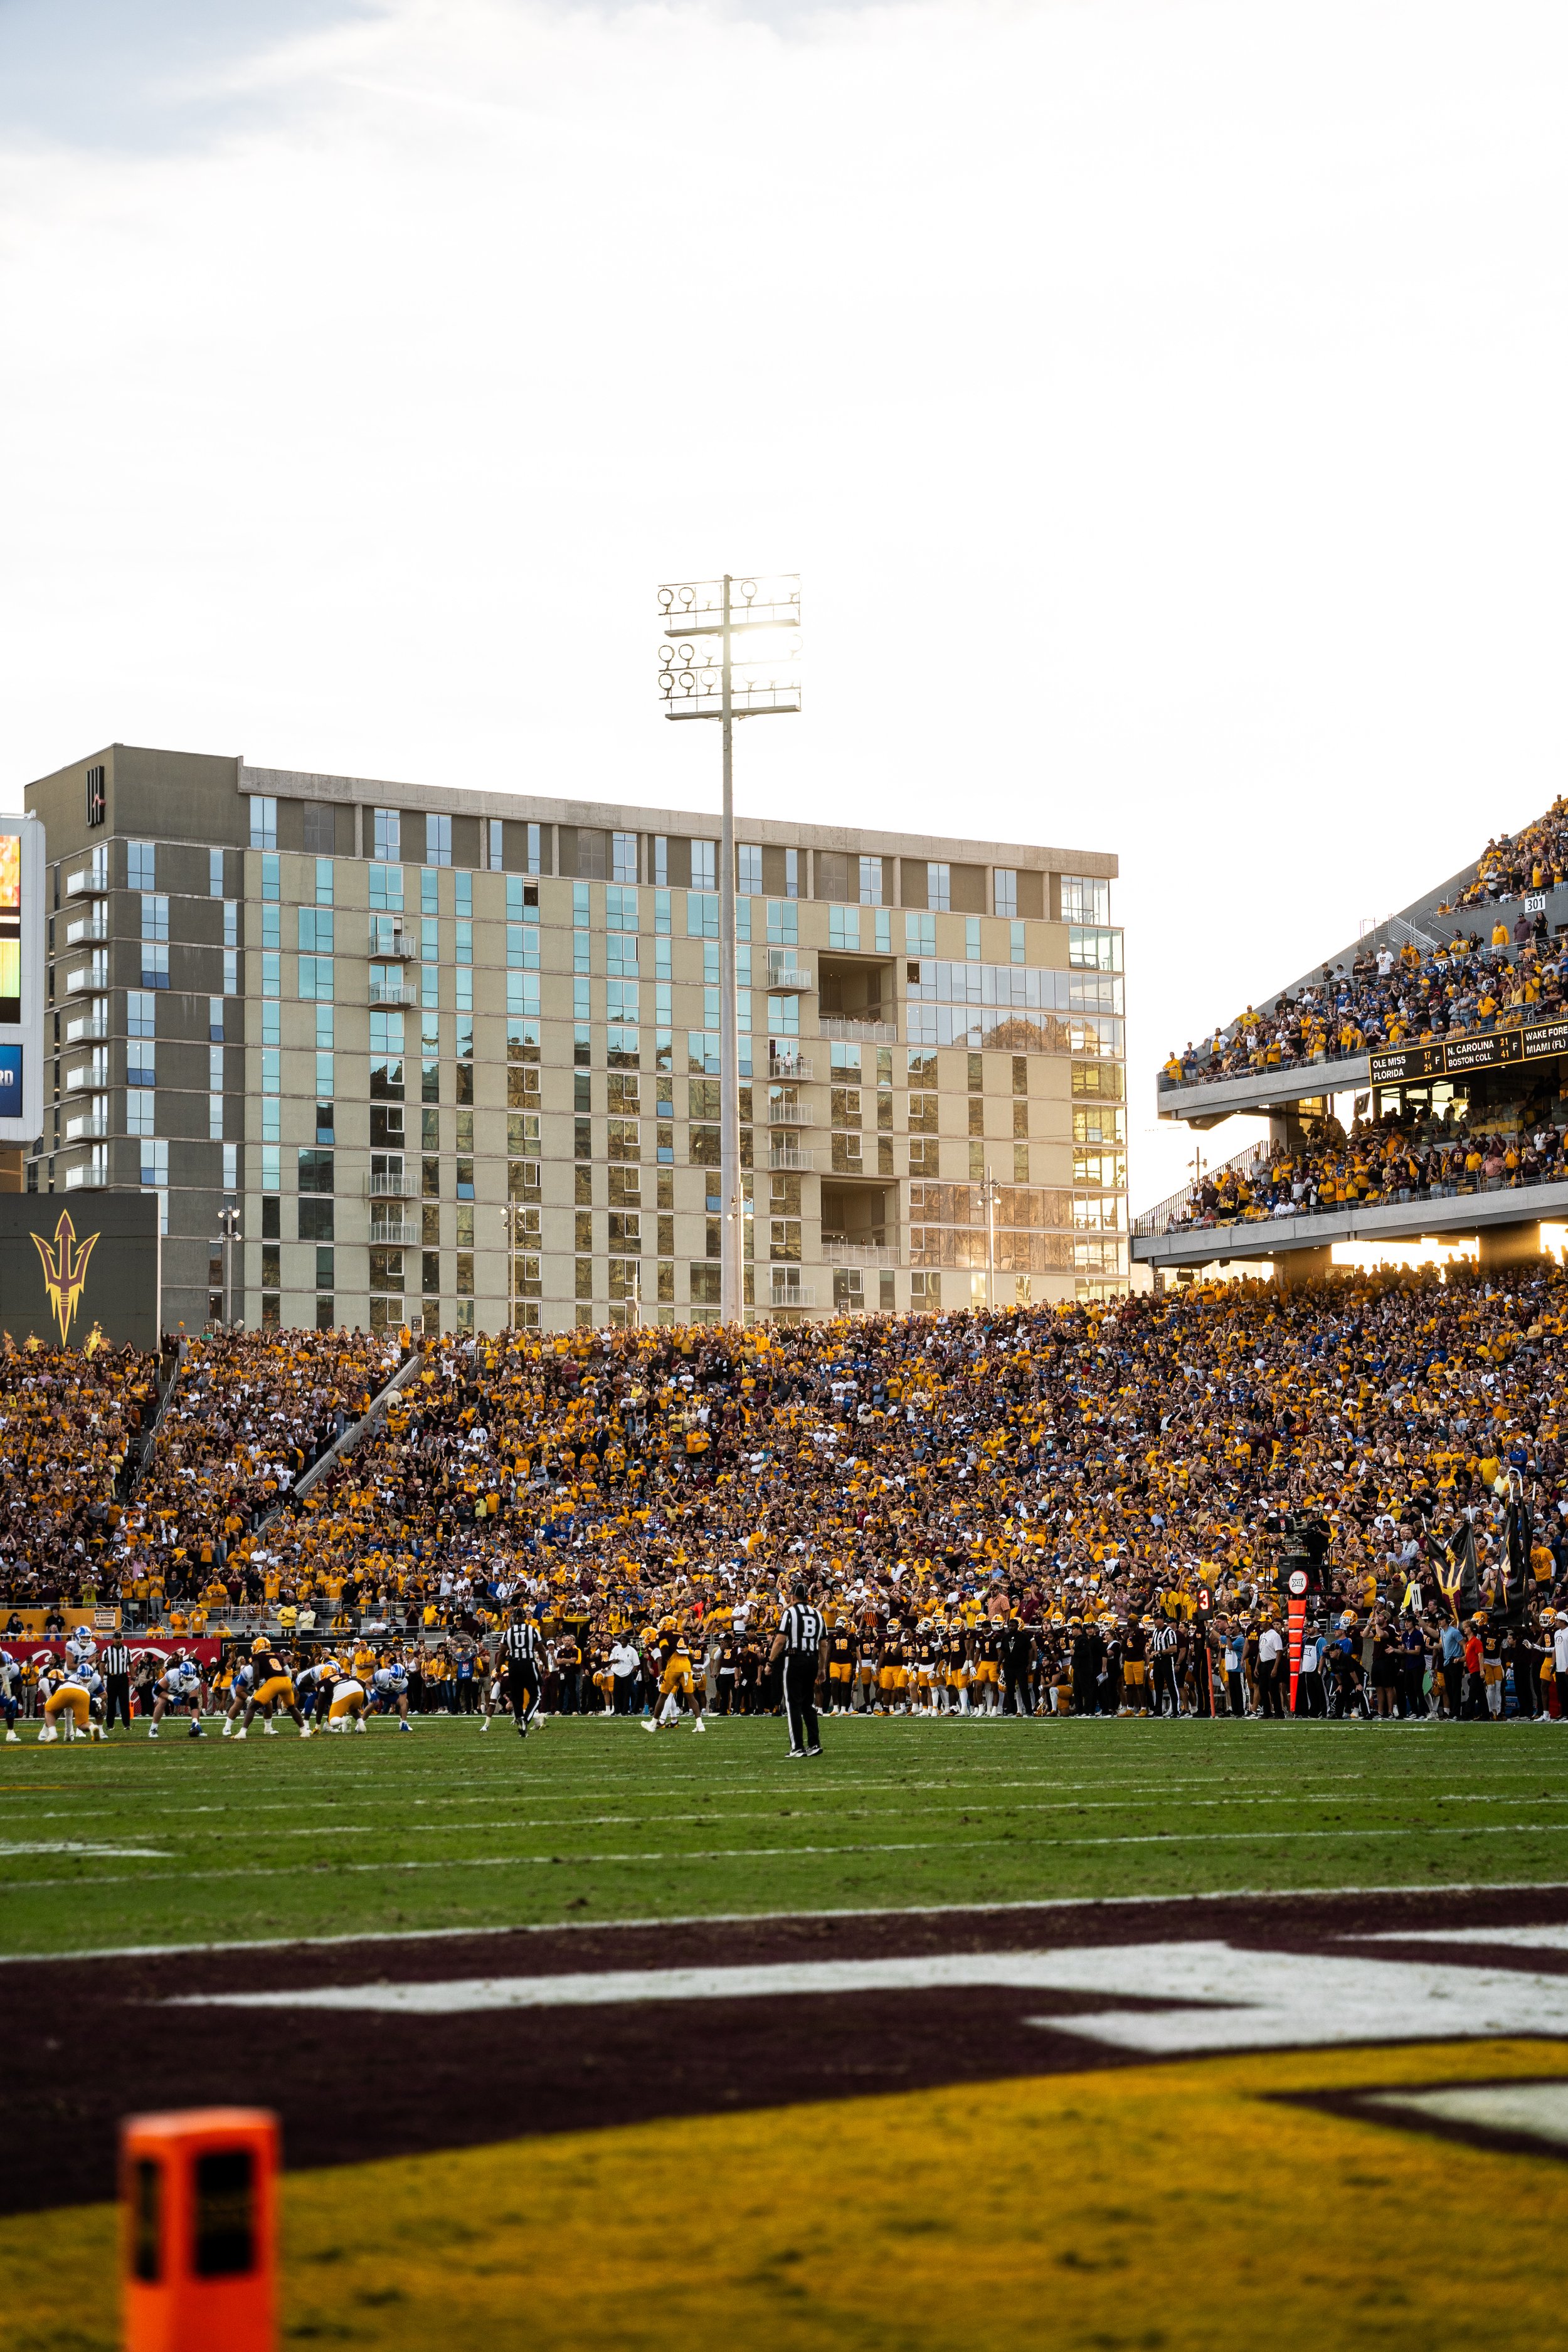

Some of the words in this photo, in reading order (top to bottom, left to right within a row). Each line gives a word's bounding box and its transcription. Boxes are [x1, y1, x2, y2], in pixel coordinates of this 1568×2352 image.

[1527, 897, 1543, 911] 301
[1525, 1030, 1547, 1041] WAKE
[1548, 1026, 1568, 1037] FORE
[1448, 1047, 1455, 1056] N.
[1456, 1040, 1494, 1055] CAROLINA
[1500, 1037, 1508, 1046] 21
[1513, 1042, 1518, 1051] F
[1527, 1042, 1550, 1054] MIAMI
[1552, 1039, 1566, 1050] (FL)
[1373, 1059, 1387, 1068] OLE
[1388, 1056, 1406, 1067] MISS
[1424, 1051, 1431, 1060] 17
[1435, 1057, 1440, 1065] F
[1448, 1056, 1474, 1067] BOSTON
[1475, 1052, 1494, 1062] COLL.
[1501, 1049, 1509, 1058] 41
[1373, 1068, 1404, 1081] FLORIDA
[1424, 1064, 1432, 1072] 24
[87, 1590, 92, 1599] 8
[1199, 1589, 1209, 1610] 3
[1413, 1589, 1419, 1605] 11
[802, 1616, 816, 1638] B
[514, 1632, 526, 1648] U
[676, 1637, 687, 1649] 4
[835, 1639, 847, 1650] 18
[984, 1641, 989, 1653] 1
[1486, 1638, 1496, 1651] 3
[724, 1649, 732, 1659] 3
[921, 1645, 929, 1657] 2
[269, 1658, 283, 1671] 8
